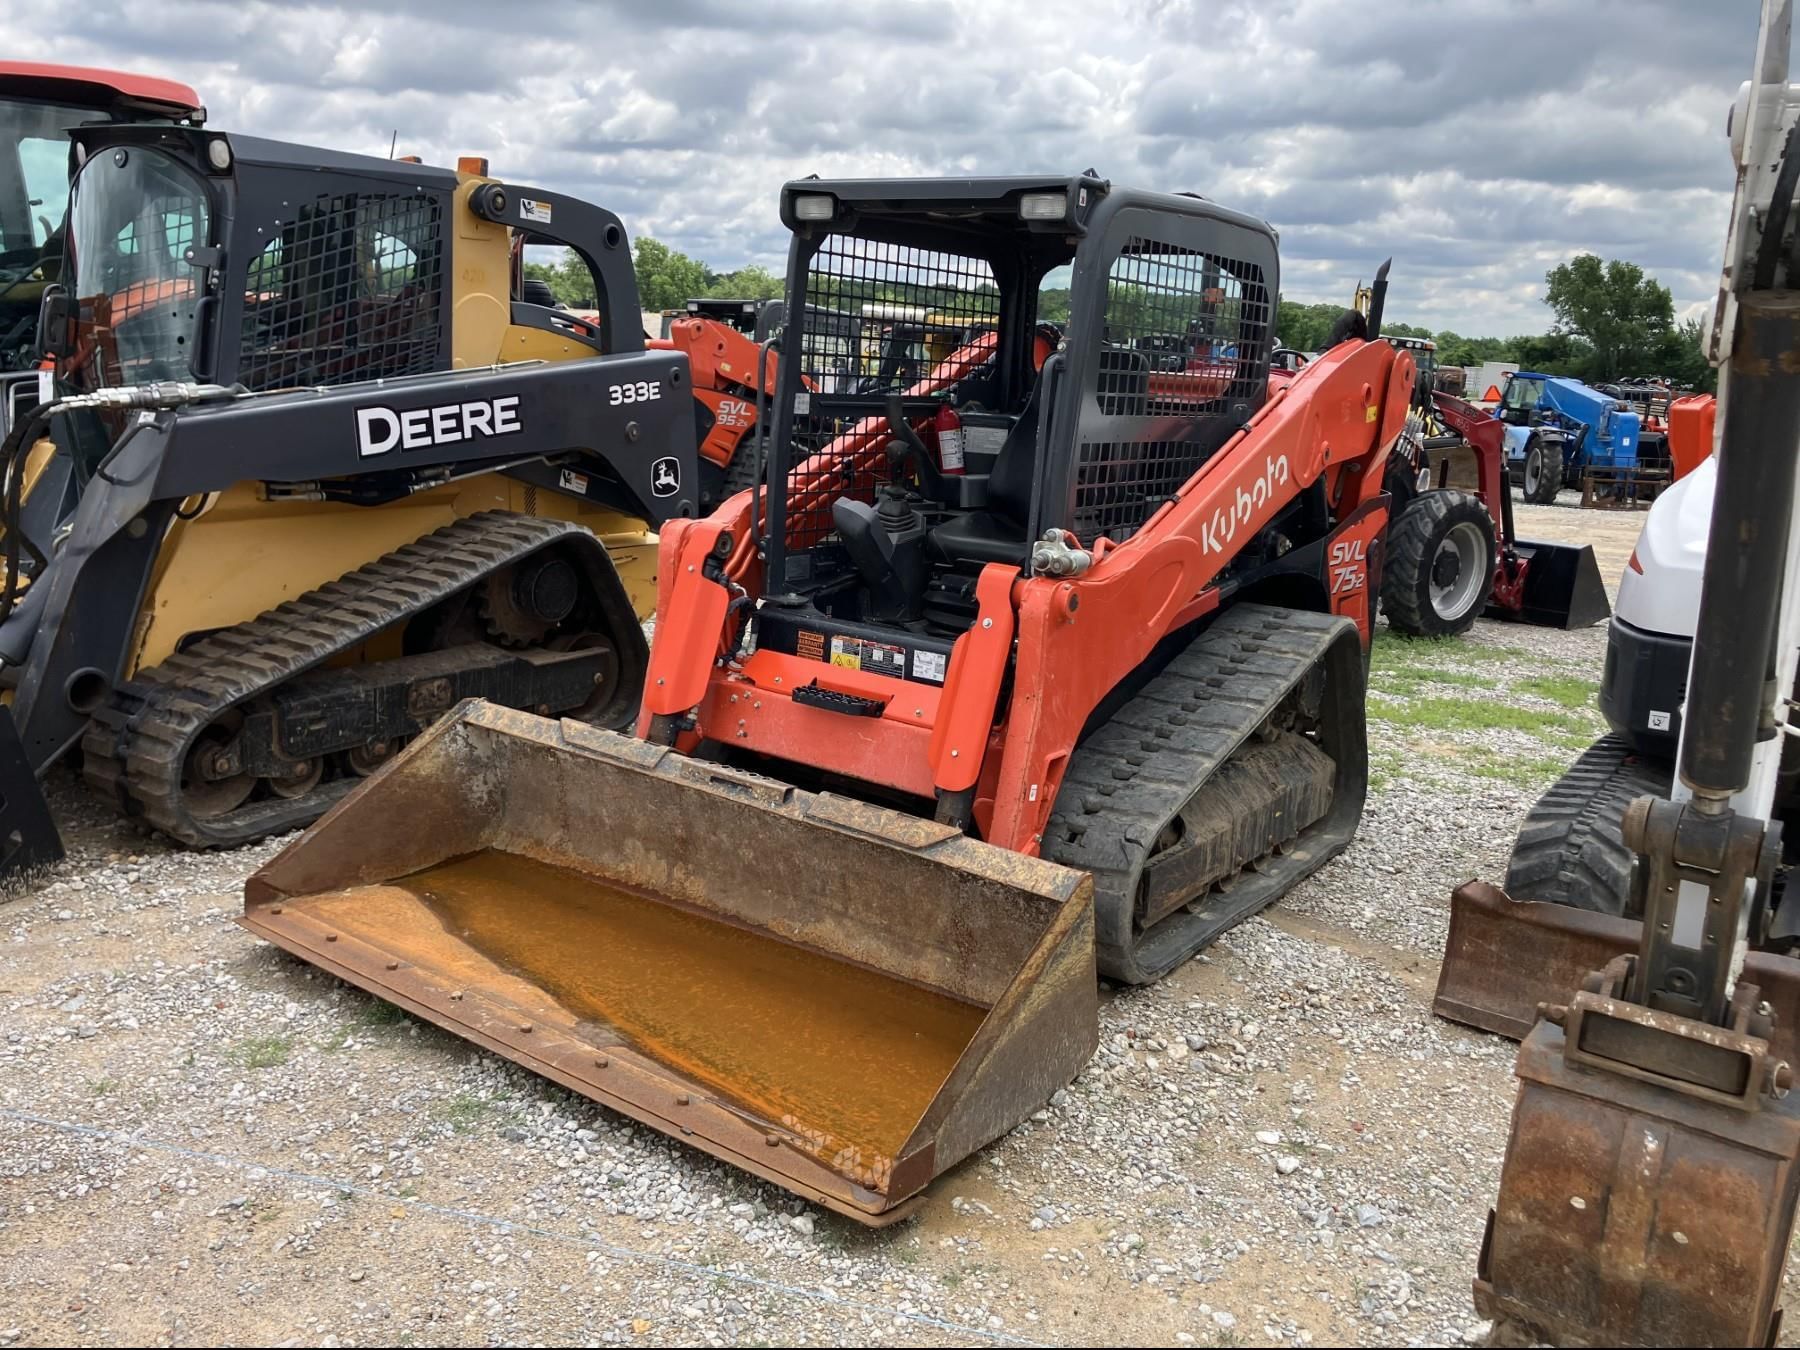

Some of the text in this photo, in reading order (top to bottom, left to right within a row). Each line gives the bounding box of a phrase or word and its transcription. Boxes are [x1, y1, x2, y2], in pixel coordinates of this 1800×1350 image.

[609, 381, 661, 406] 333E
[717, 400, 752, 416] SVL
[357, 396, 521, 456] DEERE
[1202, 454, 1288, 556] Kubota
[1329, 540, 1365, 567] SVL
[1331, 565, 1365, 595] 75-2
